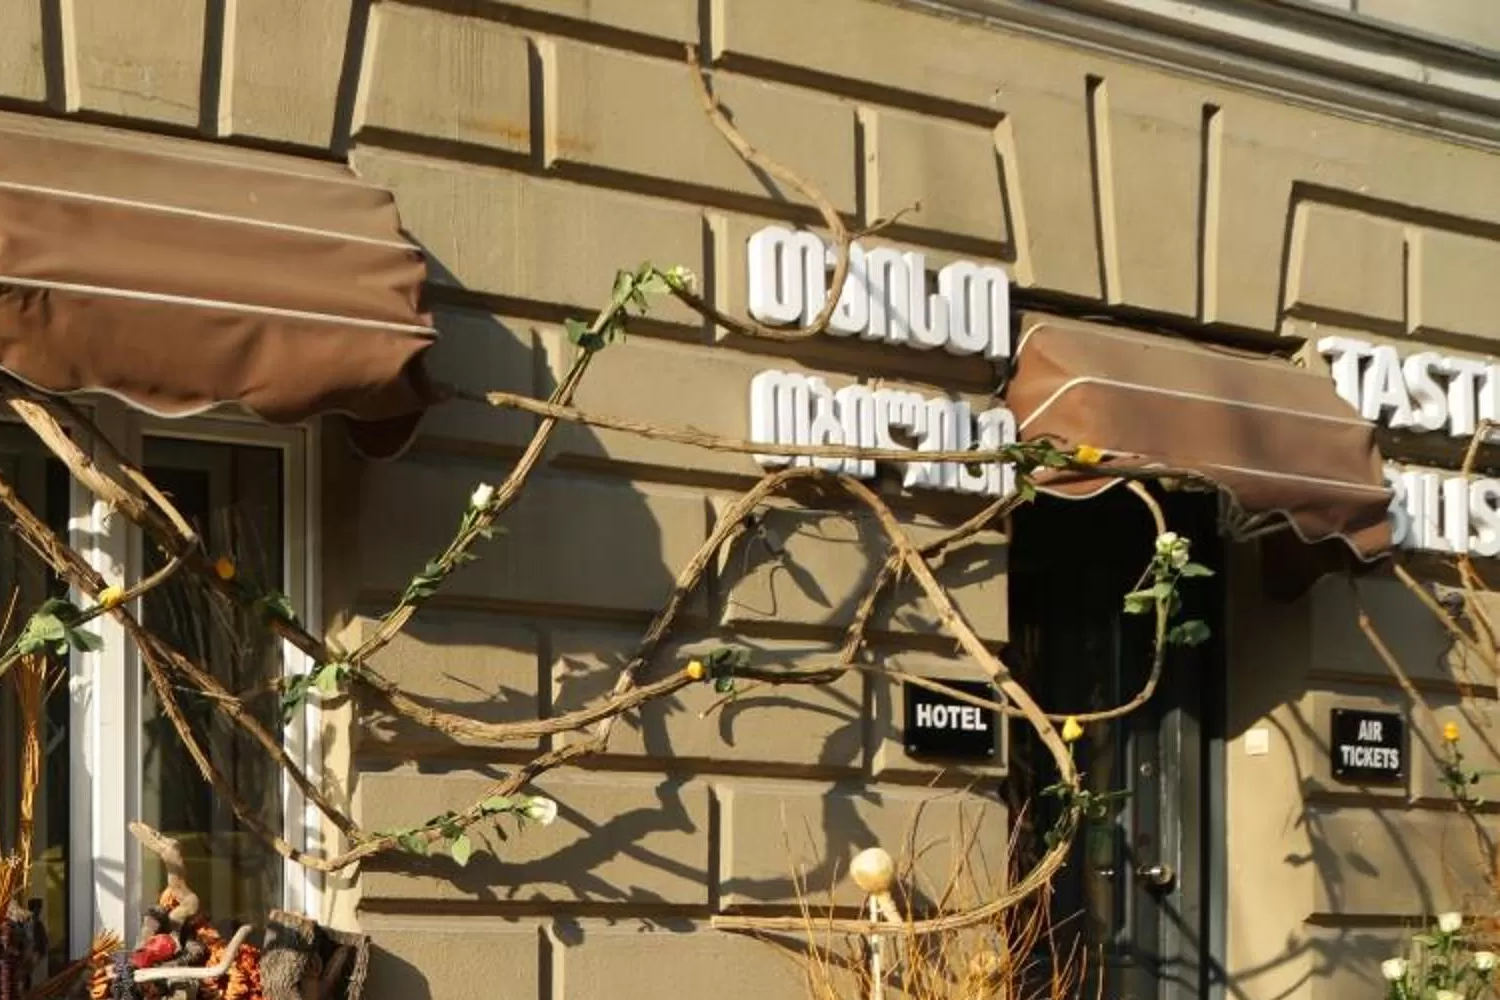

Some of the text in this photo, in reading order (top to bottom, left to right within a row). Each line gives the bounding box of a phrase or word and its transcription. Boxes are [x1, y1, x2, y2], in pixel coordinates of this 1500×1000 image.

[915, 703, 988, 731] HOTEL
[1358, 719, 1383, 743] AIR
[1340, 744, 1400, 769] TICKETS
